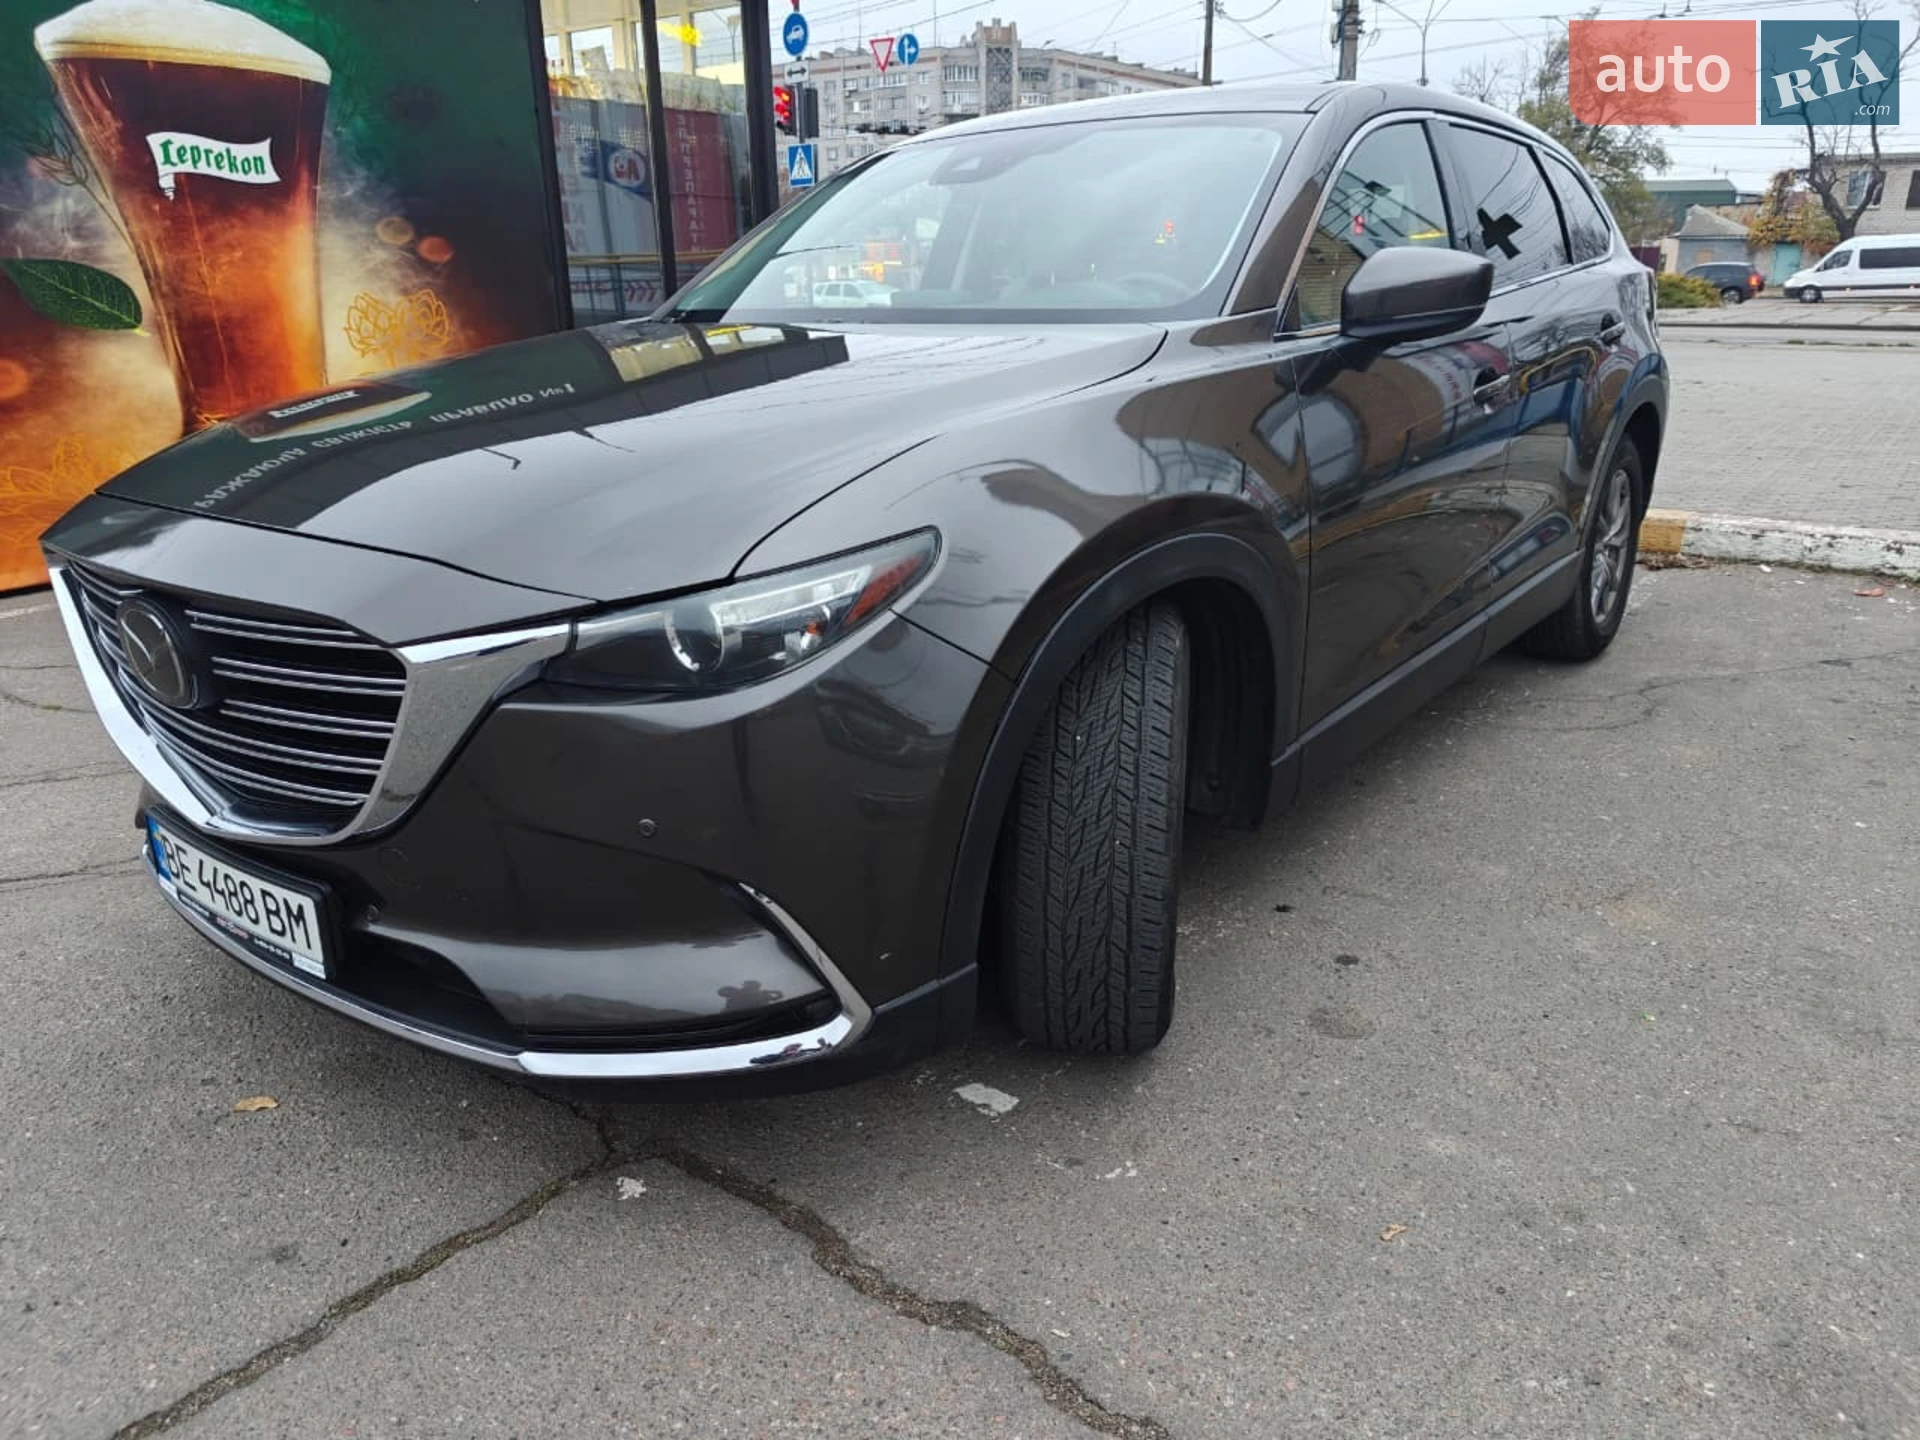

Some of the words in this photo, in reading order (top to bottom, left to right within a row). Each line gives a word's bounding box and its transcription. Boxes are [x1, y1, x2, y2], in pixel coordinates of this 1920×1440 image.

[159, 138, 266, 175] Leprekon
[161, 833, 197, 892] BE
[198, 859, 260, 925] 4488
[260, 888, 312, 950] BM
